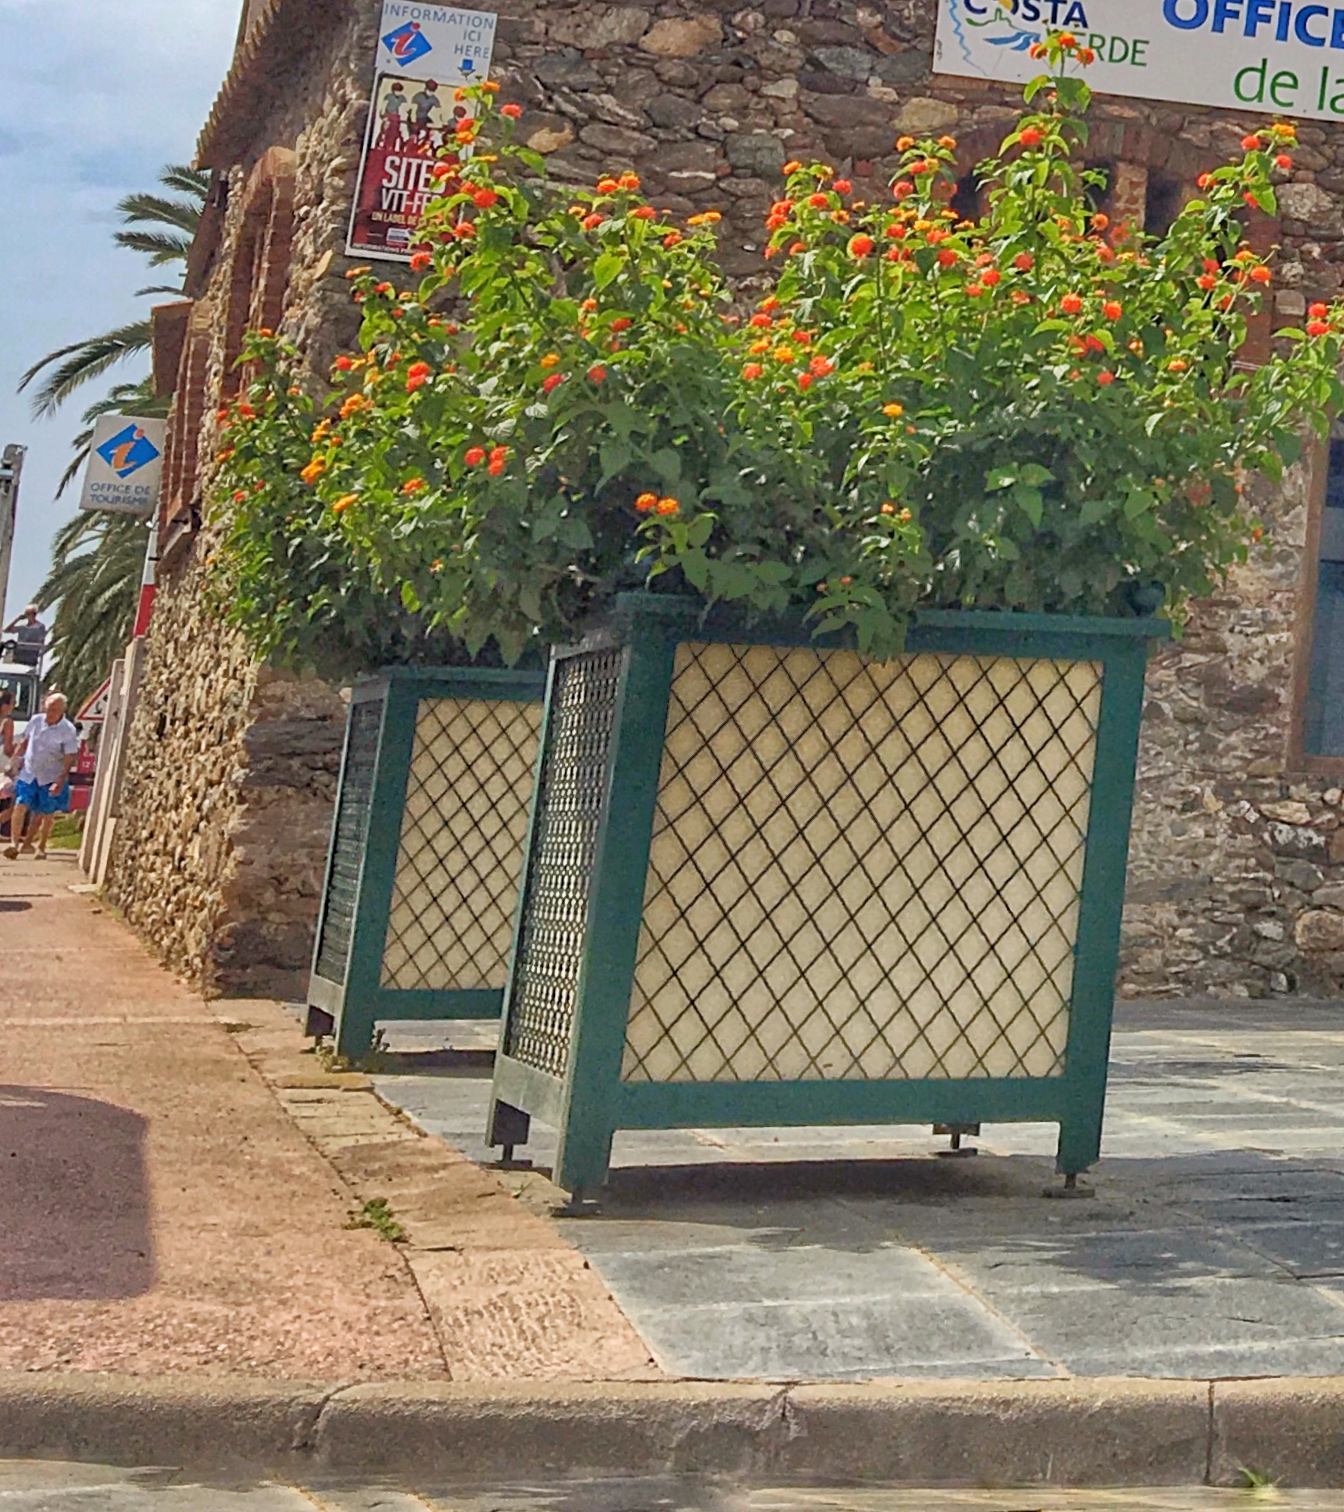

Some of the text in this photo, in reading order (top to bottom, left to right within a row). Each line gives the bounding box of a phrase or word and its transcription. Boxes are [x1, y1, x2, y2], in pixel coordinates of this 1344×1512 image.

[384, 2, 495, 30] INFORMATION
[462, 29, 482, 43] ICI
[453, 44, 490, 59] HERE
[1046, 27, 1149, 67] ERDE
[1233, 57, 1299, 108] de
[382, 188, 442, 215] VTT-FF
[383, 213, 406, 225] LABEL
[90, 483, 150, 495] OFFICE DE
[90, 494, 148, 505] TOURISME
